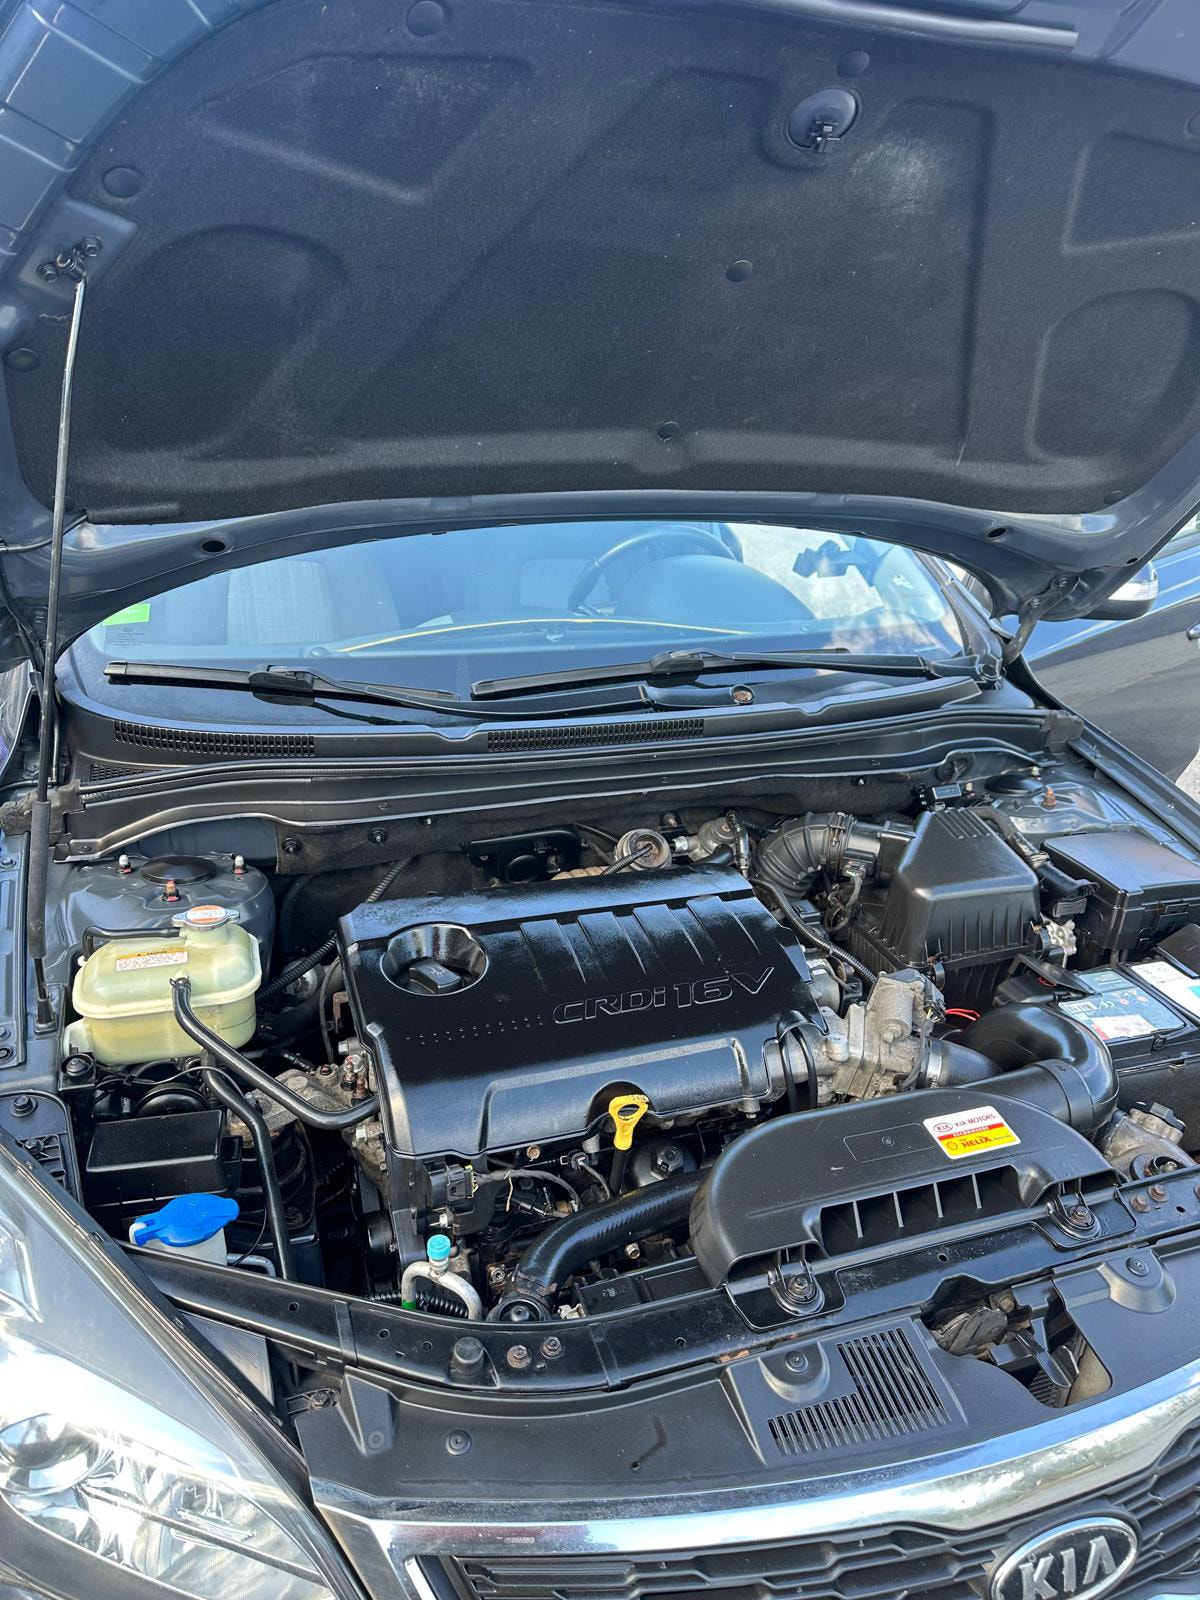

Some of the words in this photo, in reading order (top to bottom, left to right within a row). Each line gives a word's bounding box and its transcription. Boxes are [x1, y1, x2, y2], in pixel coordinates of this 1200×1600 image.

[552, 986, 666, 1025] CRDi
[673, 966, 775, 1009] 16V
[968, 1113, 996, 1124] MOTORS
[961, 1136, 992, 1148] HELIX
[1018, 1535, 1117, 1600] KIA
